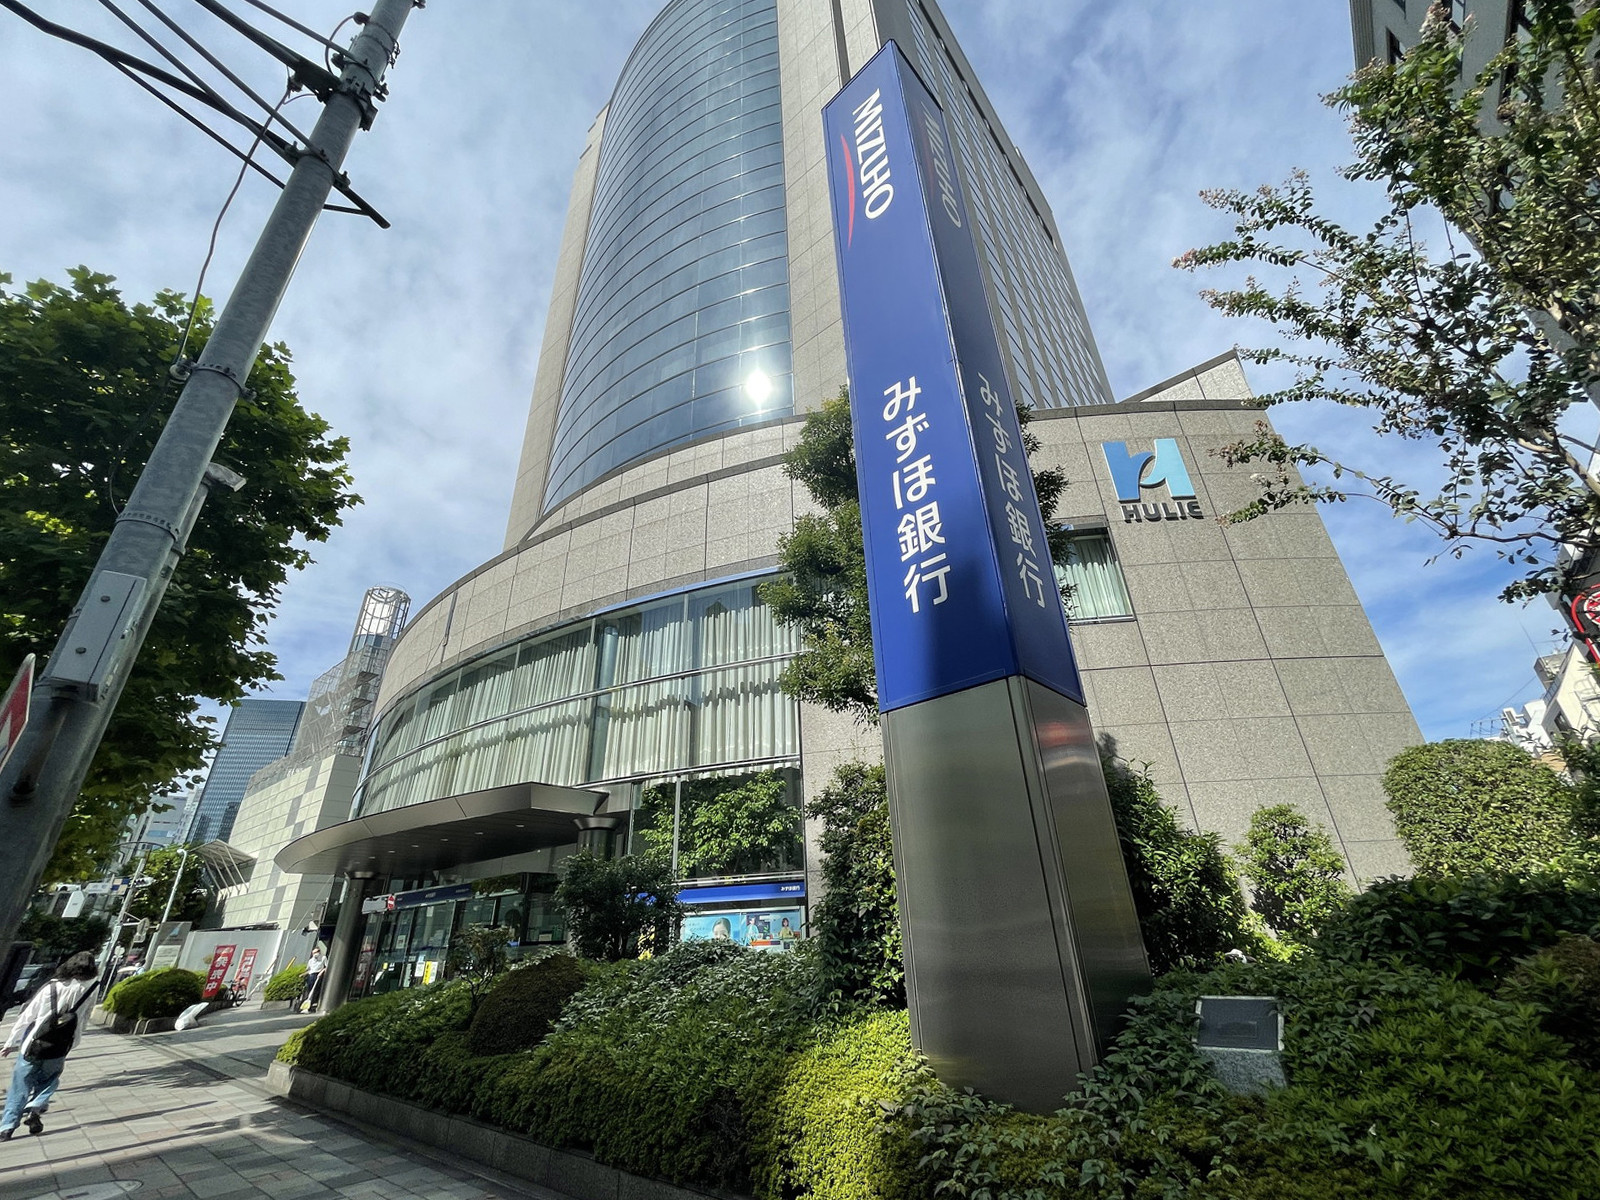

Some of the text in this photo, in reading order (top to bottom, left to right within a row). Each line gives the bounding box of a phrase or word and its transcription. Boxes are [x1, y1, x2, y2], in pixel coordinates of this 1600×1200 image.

[852, 88, 894, 220] MIZUHO
[921, 101, 961, 228] MIZUHO
[883, 376, 950, 613] みずほ銀行
[978, 372, 1045, 608] みずほ銀行
